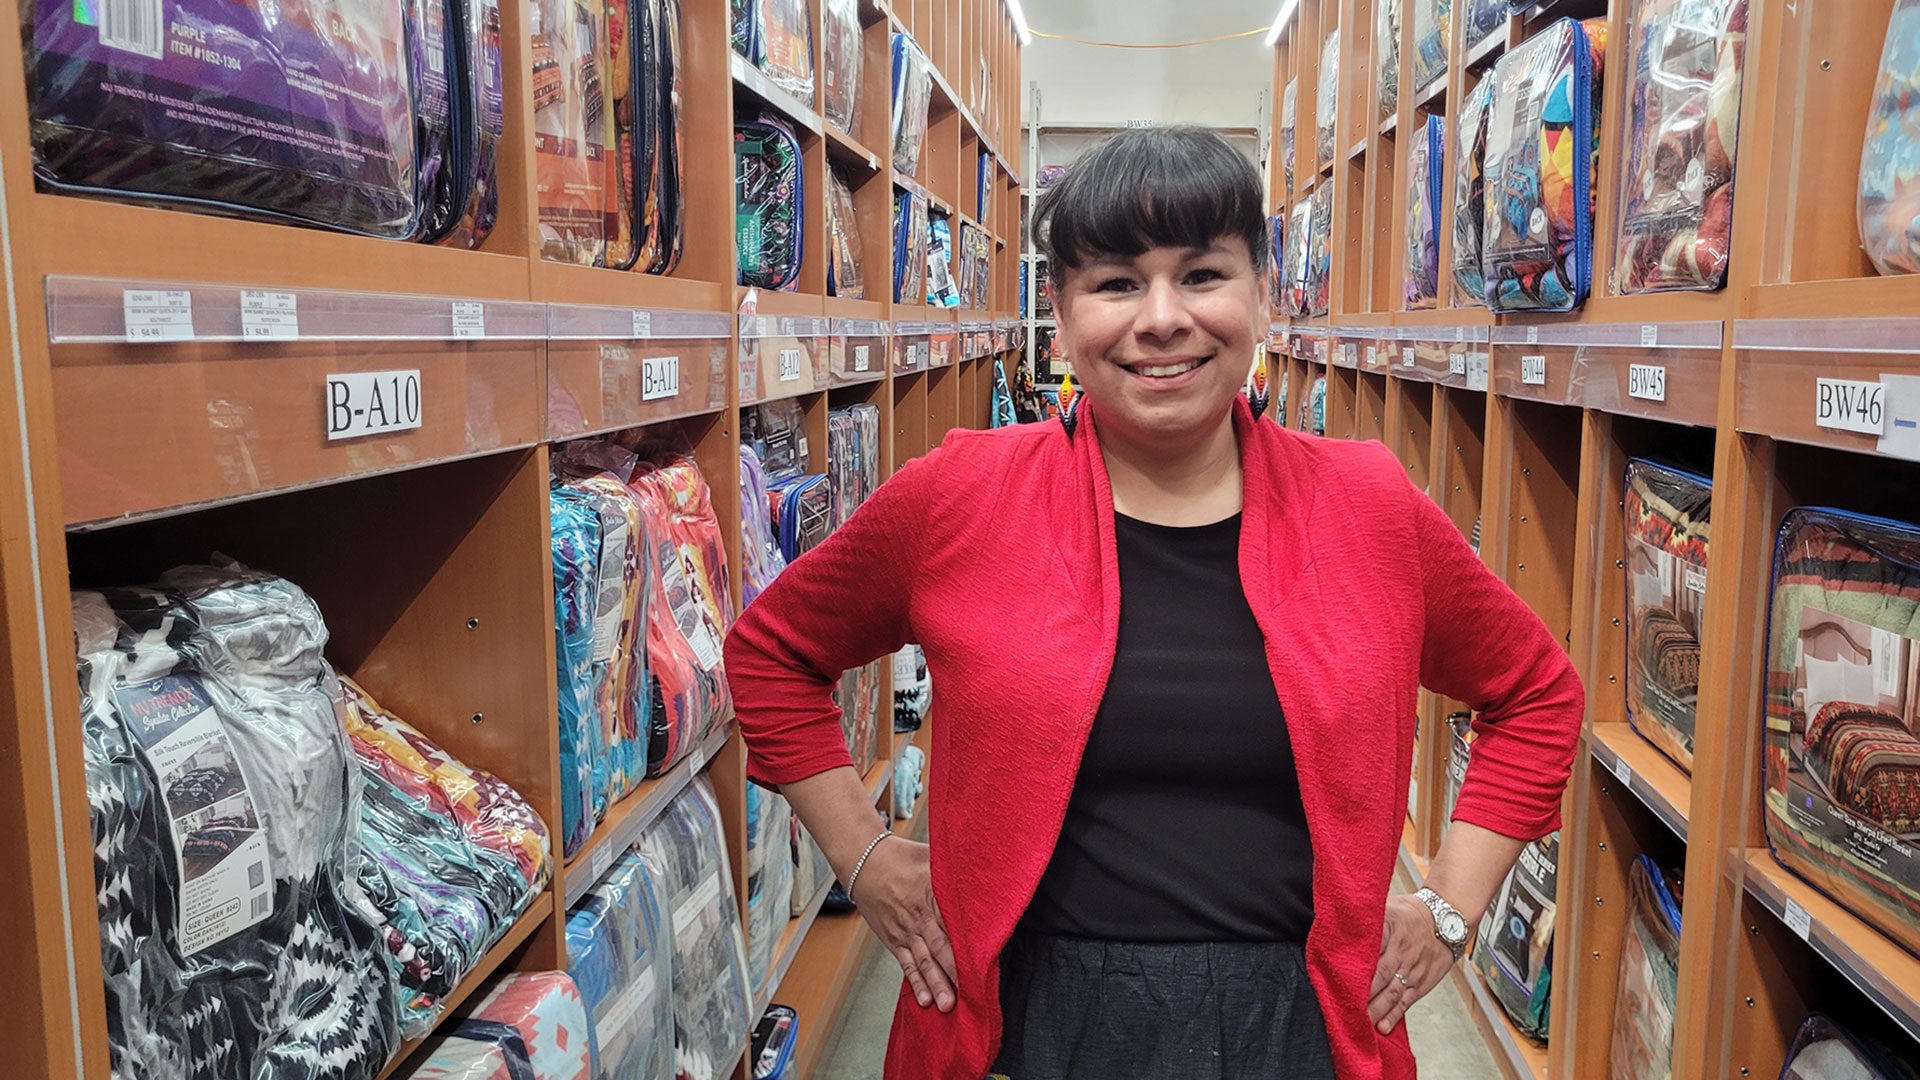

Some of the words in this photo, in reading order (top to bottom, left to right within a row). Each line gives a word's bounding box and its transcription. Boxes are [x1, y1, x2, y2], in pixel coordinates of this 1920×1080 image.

[171, 21, 206, 44] PURPLE
[171, 40, 193, 57] ITEM
[644, 360, 677, 394] B-A11
[1522, 359, 1543, 380] BW44
[1630, 367, 1663, 397] BW45
[329, 375, 419, 433] B-A10
[1818, 383, 1882, 425] BW46
[164, 743, 179, 754] Touch
[180, 735, 203, 747] Reversible
[203, 729, 221, 740] Blanket
[1828, 804, 1844, 821] Queen
[1844, 813, 1856, 828] Size
[1856, 820, 1876, 838] Sherpa
[1876, 829, 1891, 846] Lined
[1891, 839, 1912, 858] Blanket
[205, 909, 224, 923] QUEEN
[183, 938, 206, 952] DESIGN
